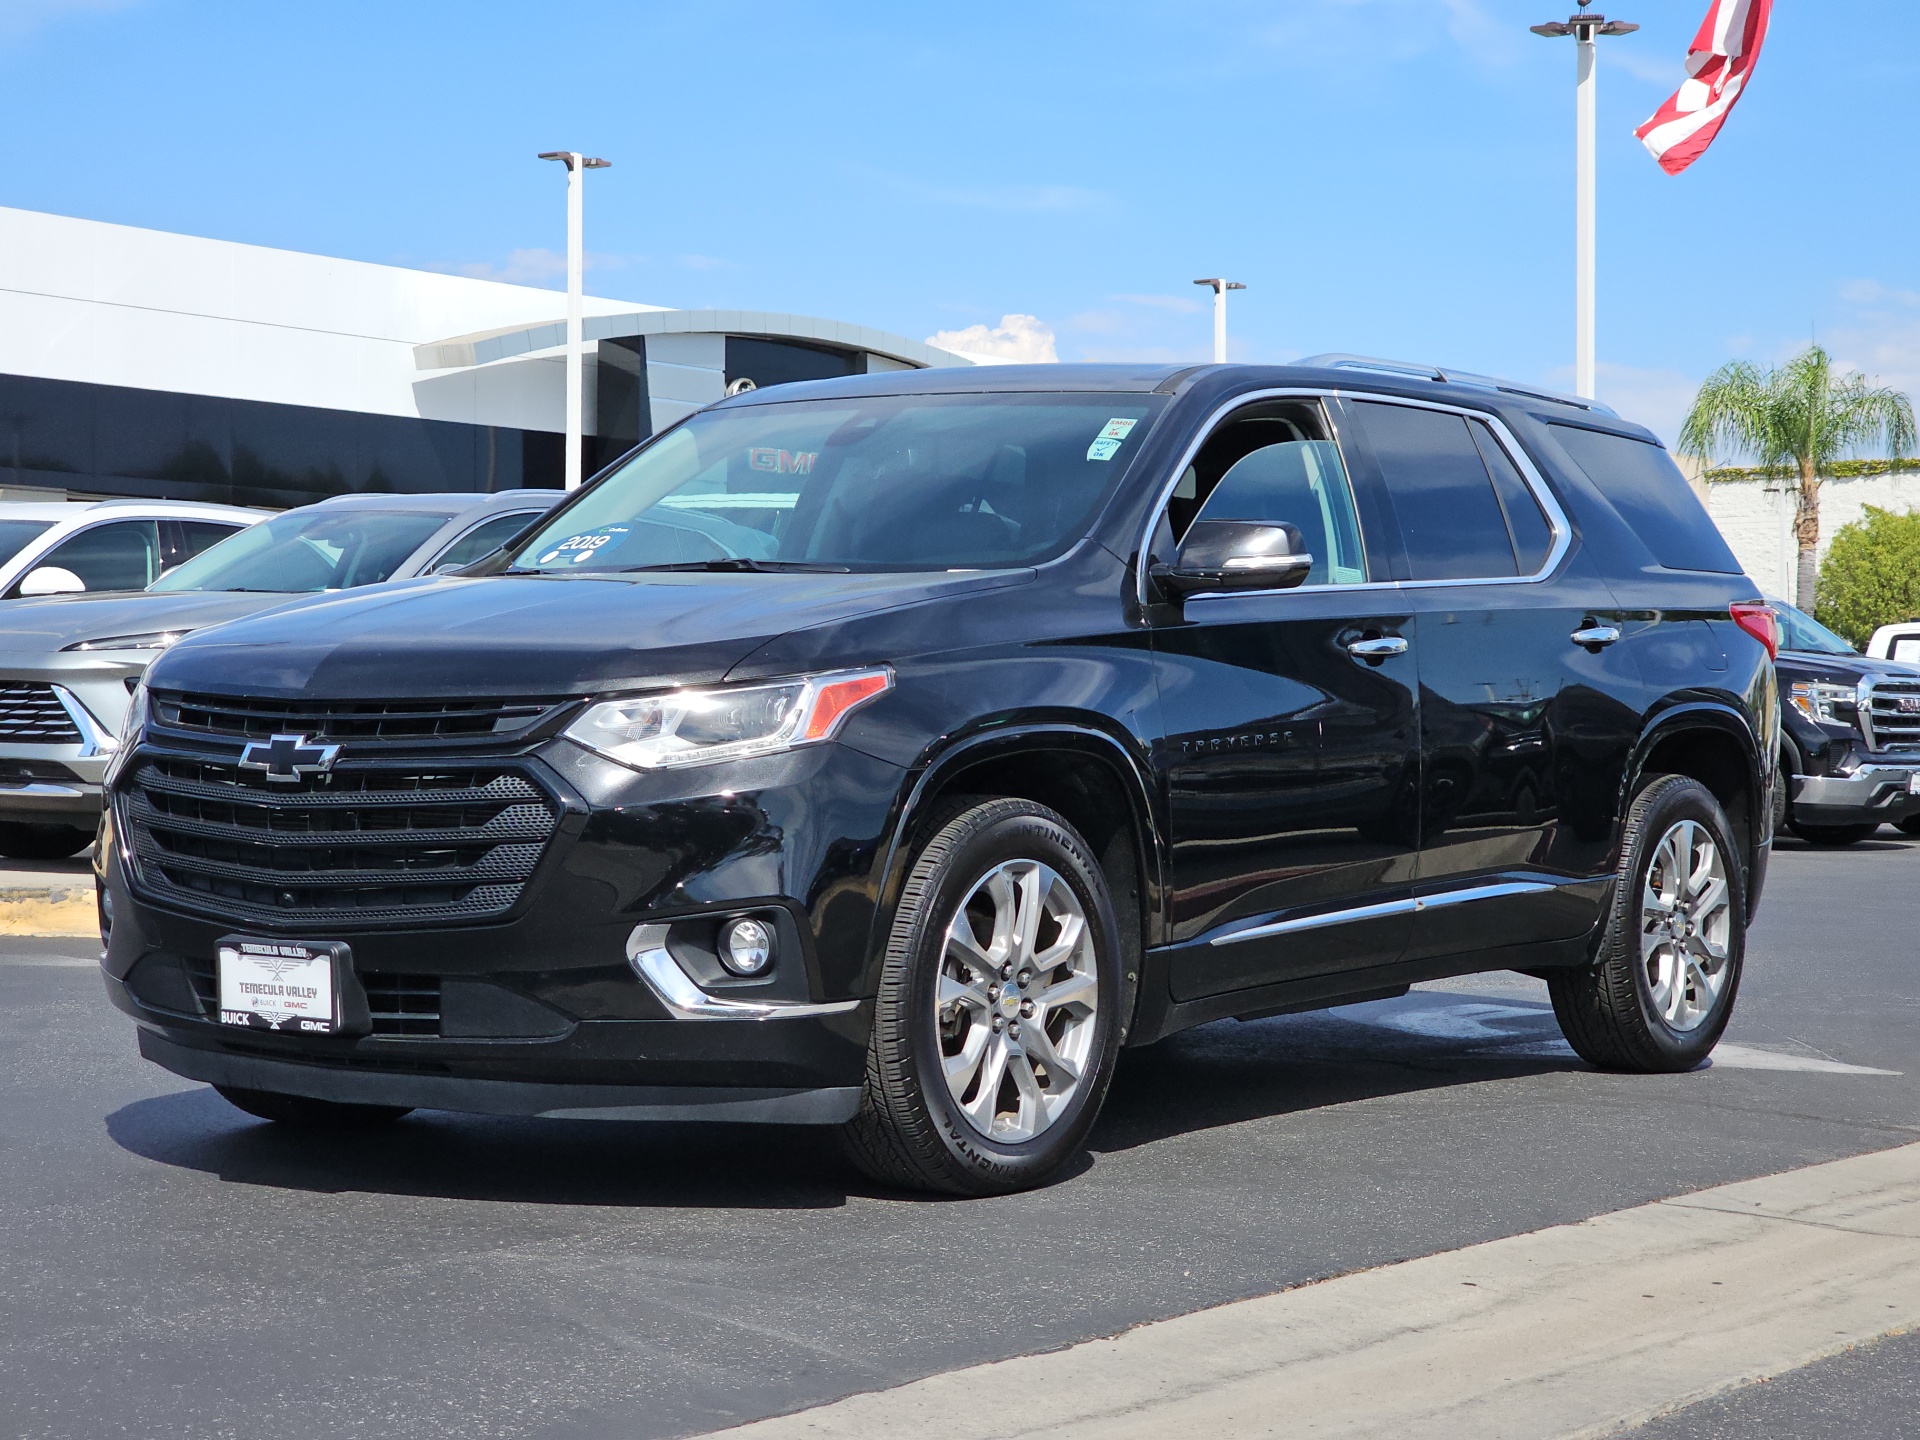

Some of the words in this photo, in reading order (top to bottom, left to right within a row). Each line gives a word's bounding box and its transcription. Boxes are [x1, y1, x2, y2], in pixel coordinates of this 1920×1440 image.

[557, 535, 611, 550] 2019
[240, 943, 279, 955] TEMECULA
[279, 946, 307, 958] VALLEY
[239, 982, 284, 996] TEMECULA
[285, 985, 317, 998] VALLEY
[259, 999, 276, 1007] BUICK
[283, 1001, 308, 1009] GMC
[221, 1011, 250, 1026] BUICK
[300, 1020, 330, 1032] GMC
